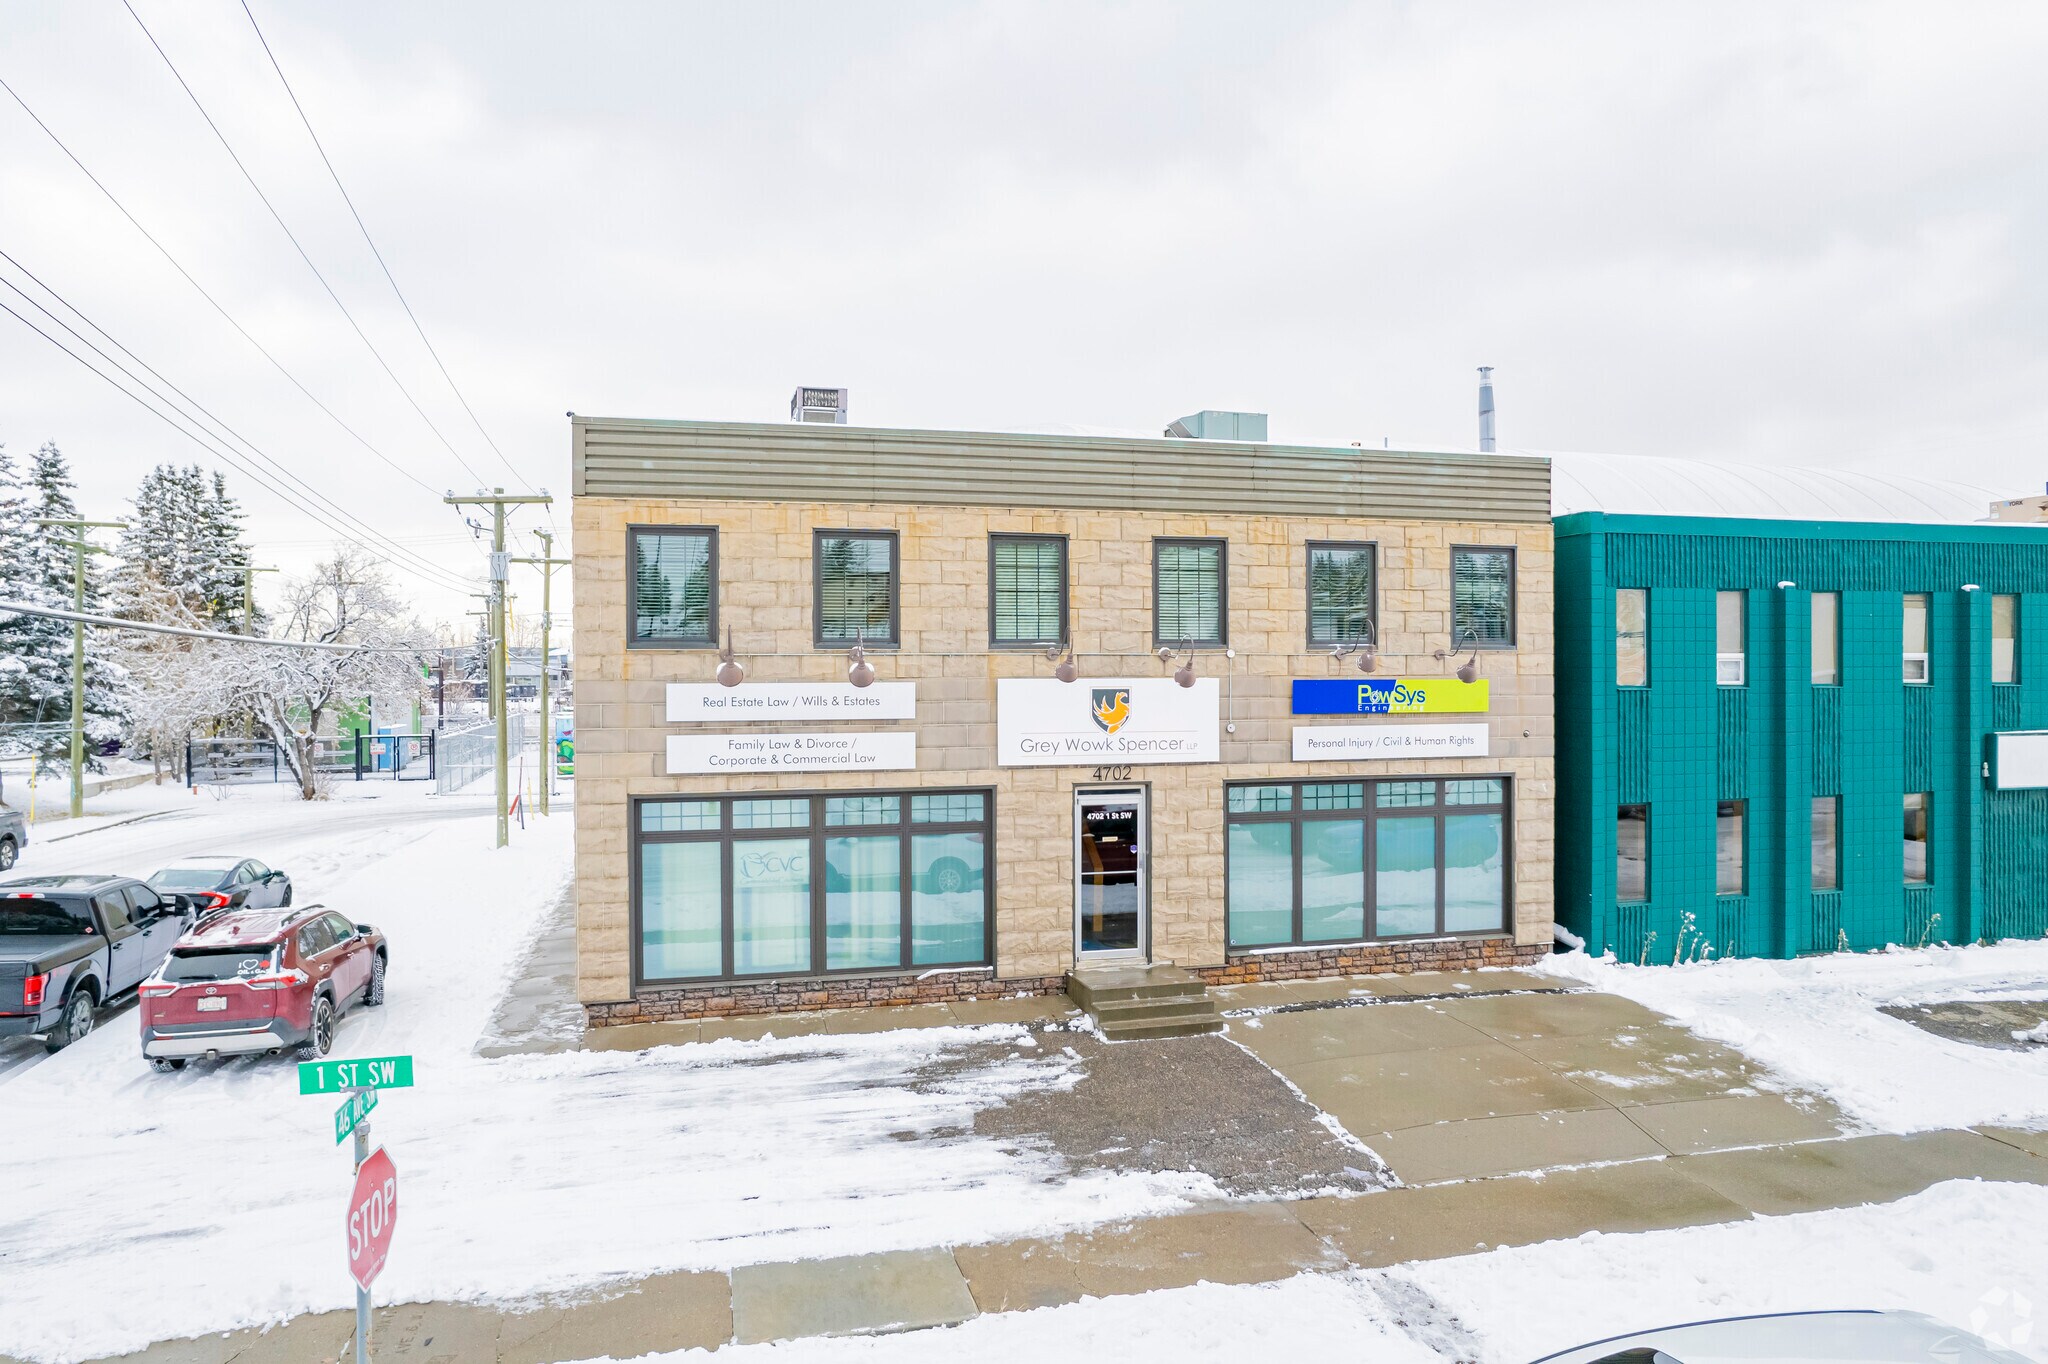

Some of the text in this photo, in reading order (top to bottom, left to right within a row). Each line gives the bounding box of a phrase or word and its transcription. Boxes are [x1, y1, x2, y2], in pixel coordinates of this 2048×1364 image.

[703, 695, 880, 708] Real Estate Law / Wills & Estates
[1357, 684, 1426, 706] PowSys
[728, 738, 858, 752] Family Law & Divorce /
[1020, 737, 1198, 755] Grey Wowk Spencer LLP
[1308, 735, 1474, 749] Personal Injury / Civil & Human Rights
[708, 753, 876, 768] Corporate & Commercial Law
[1092, 766, 1132, 782] 4702
[316, 1060, 396, 1090] 1 ST SW
[338, 1108, 351, 1135] 46
[353, 1097, 365, 1123] AVE
[350, 1176, 396, 1262] STOP
